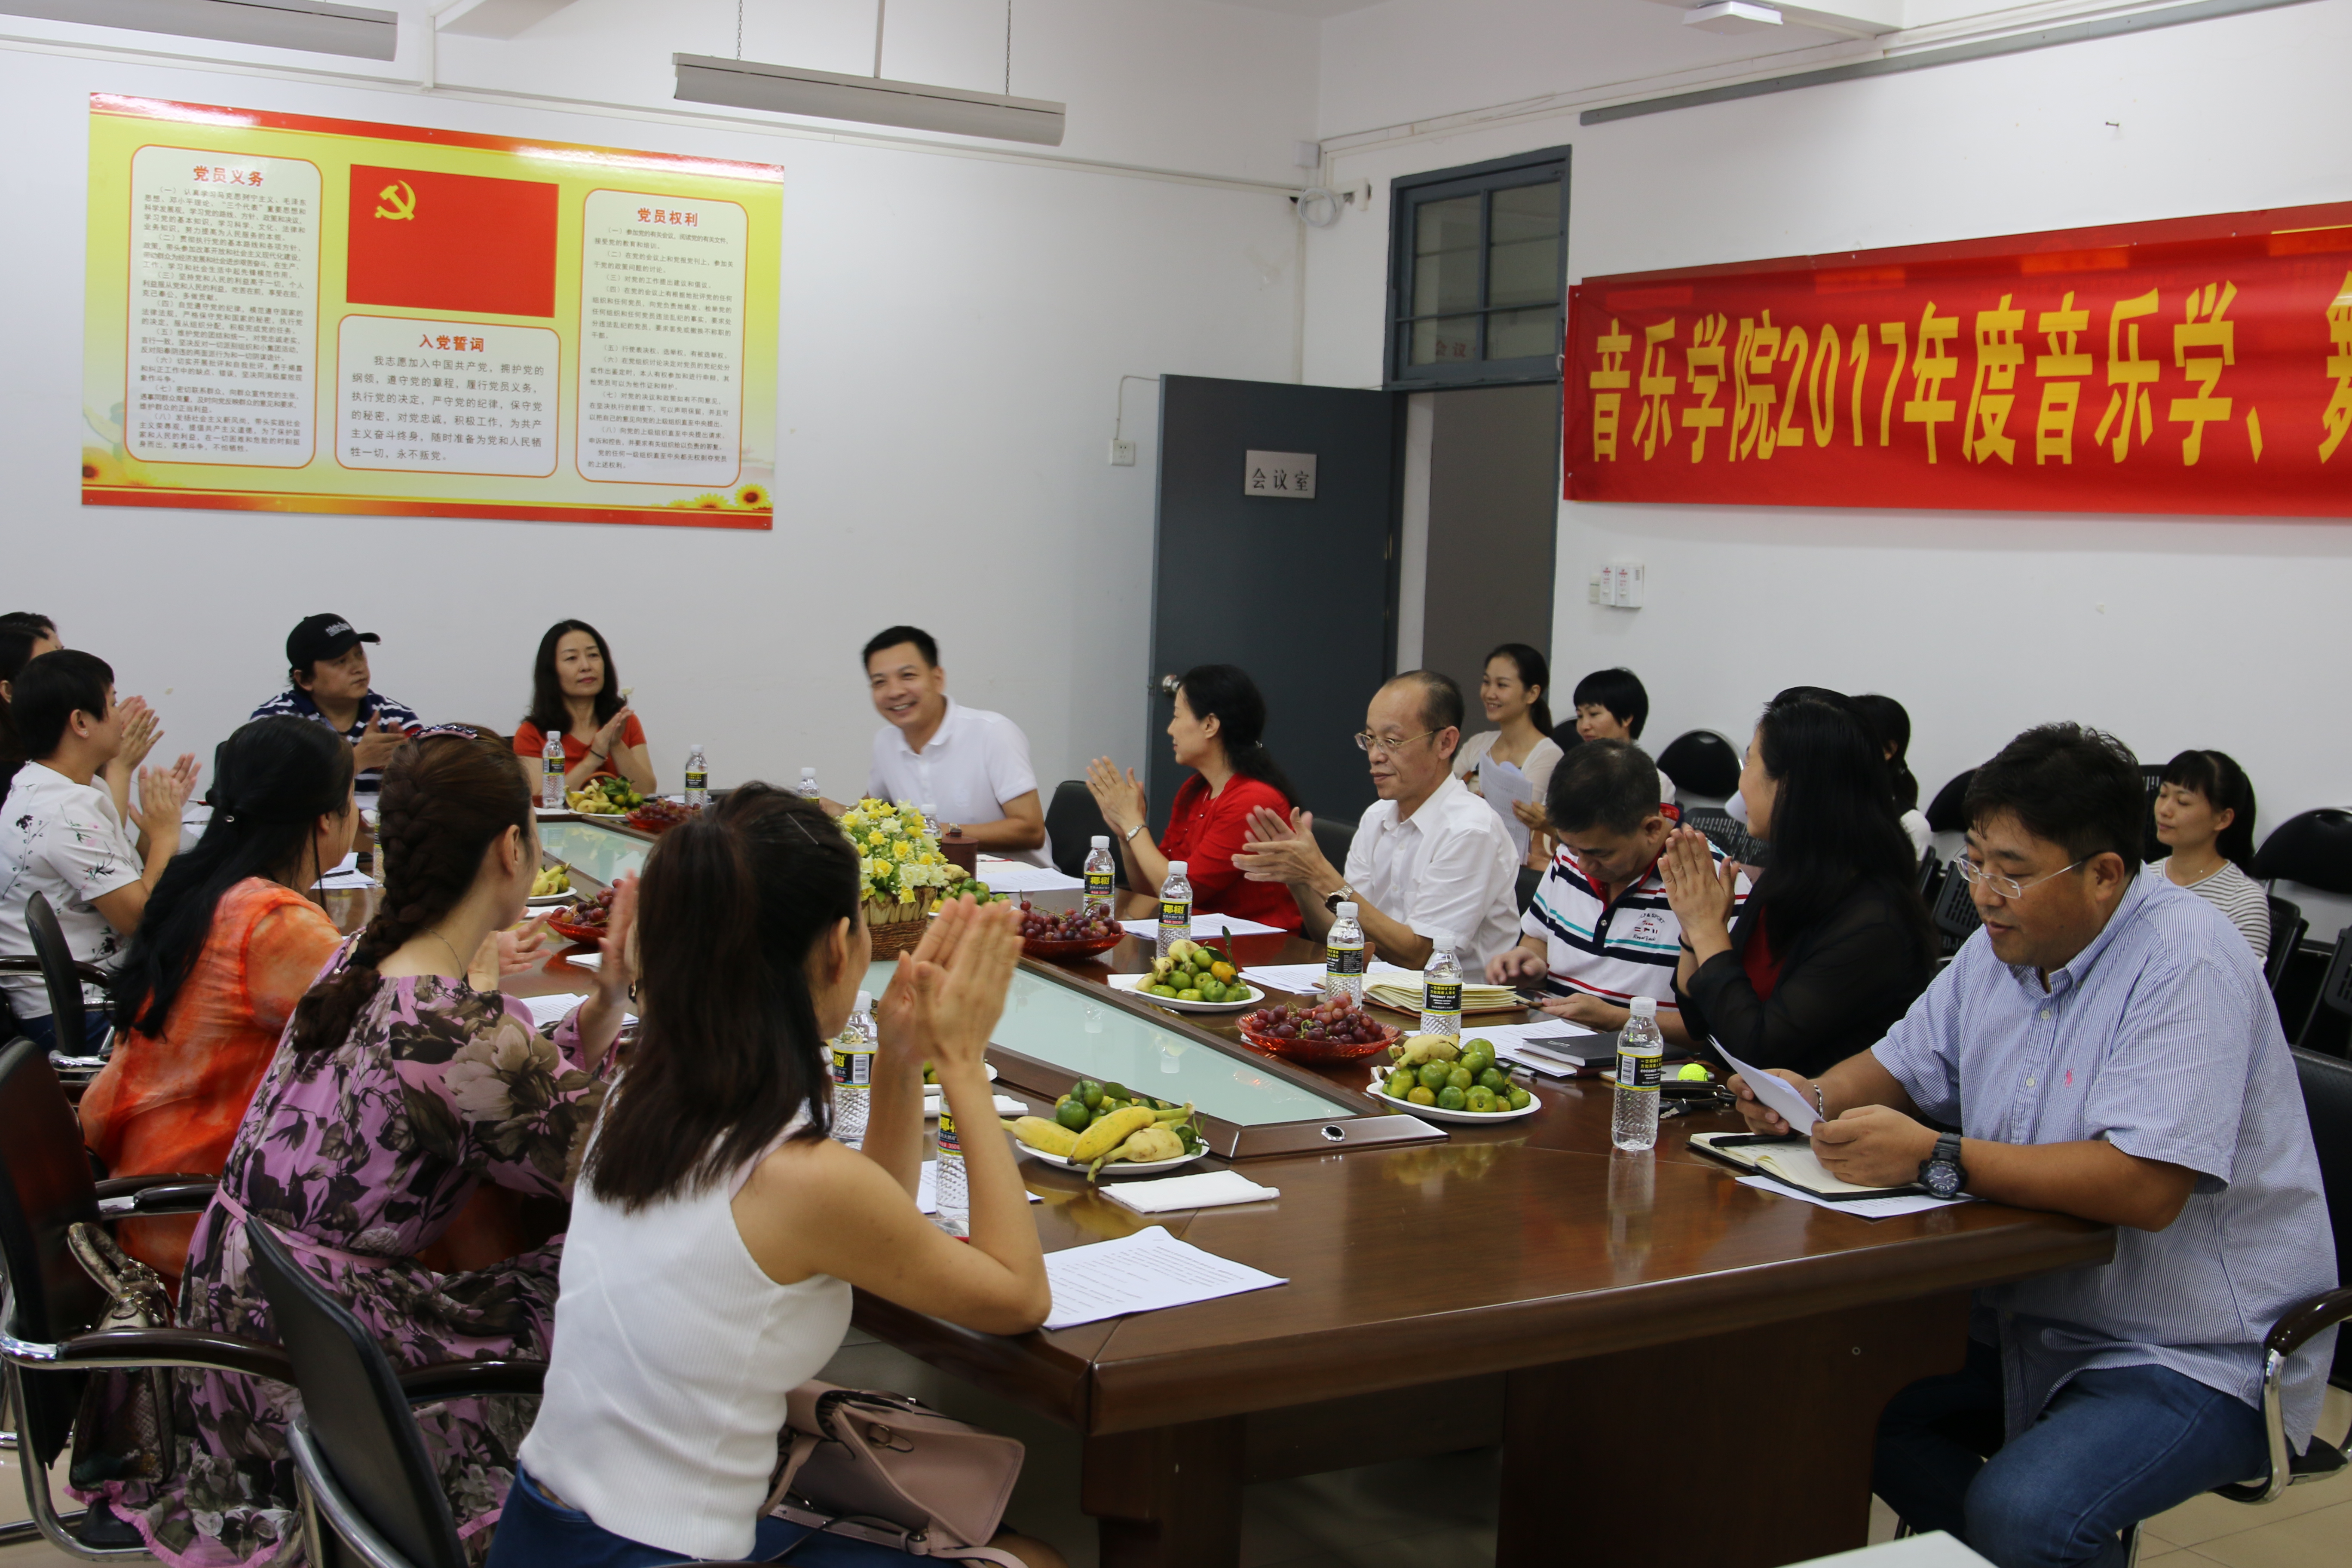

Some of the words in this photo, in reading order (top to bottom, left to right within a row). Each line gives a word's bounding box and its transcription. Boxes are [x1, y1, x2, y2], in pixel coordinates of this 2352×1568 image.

[193, 165, 263, 187] 党员义务
[638, 208, 698, 227] 党员权利
[419, 334, 484, 352] 入党誓词
[350, 447, 446, 460] 牲一切，永不叛党。
[1253, 468, 1309, 491] 会议室
